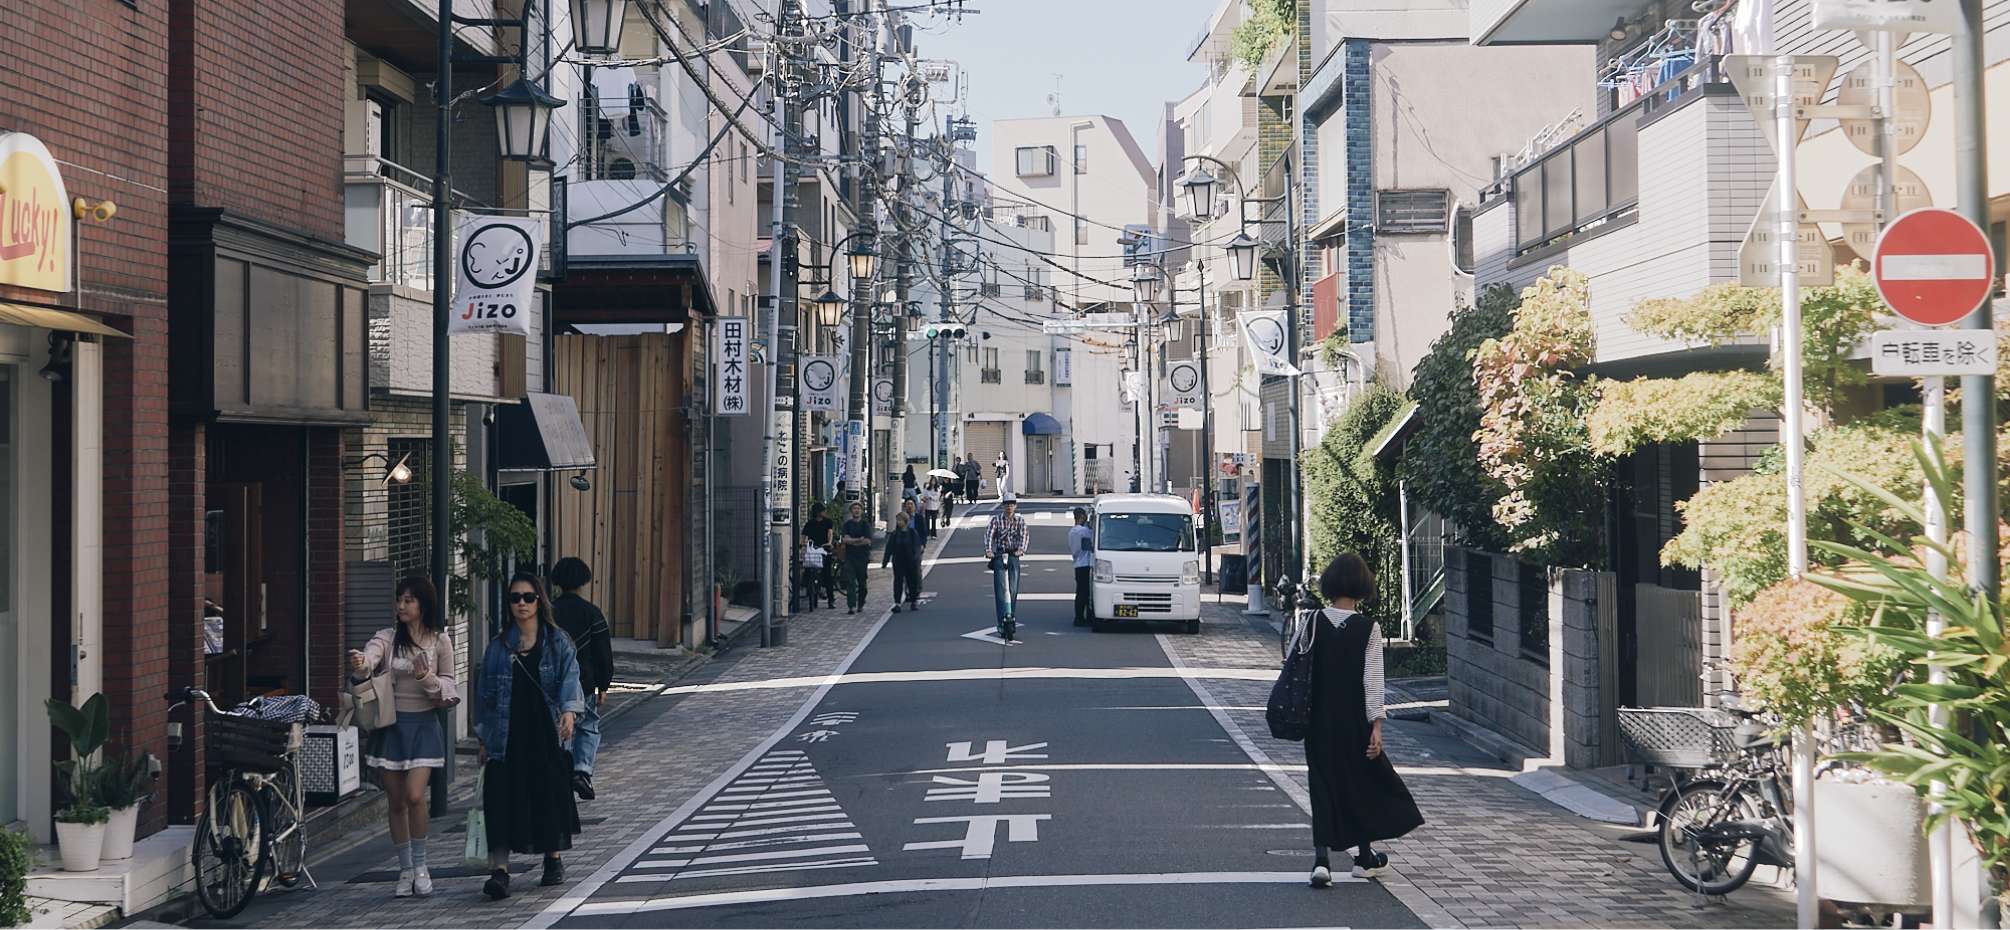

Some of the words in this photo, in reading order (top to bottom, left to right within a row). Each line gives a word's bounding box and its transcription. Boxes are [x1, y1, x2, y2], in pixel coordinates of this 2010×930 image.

[0, 186, 58, 272] Lucky!
[462, 302, 516, 320] Jizo
[723, 322, 744, 411] 田村木材(株)
[806, 396, 831, 405] Jizo
[1174, 396, 1196, 404] Jizo
[777, 430, 788, 491] ねこの病院
